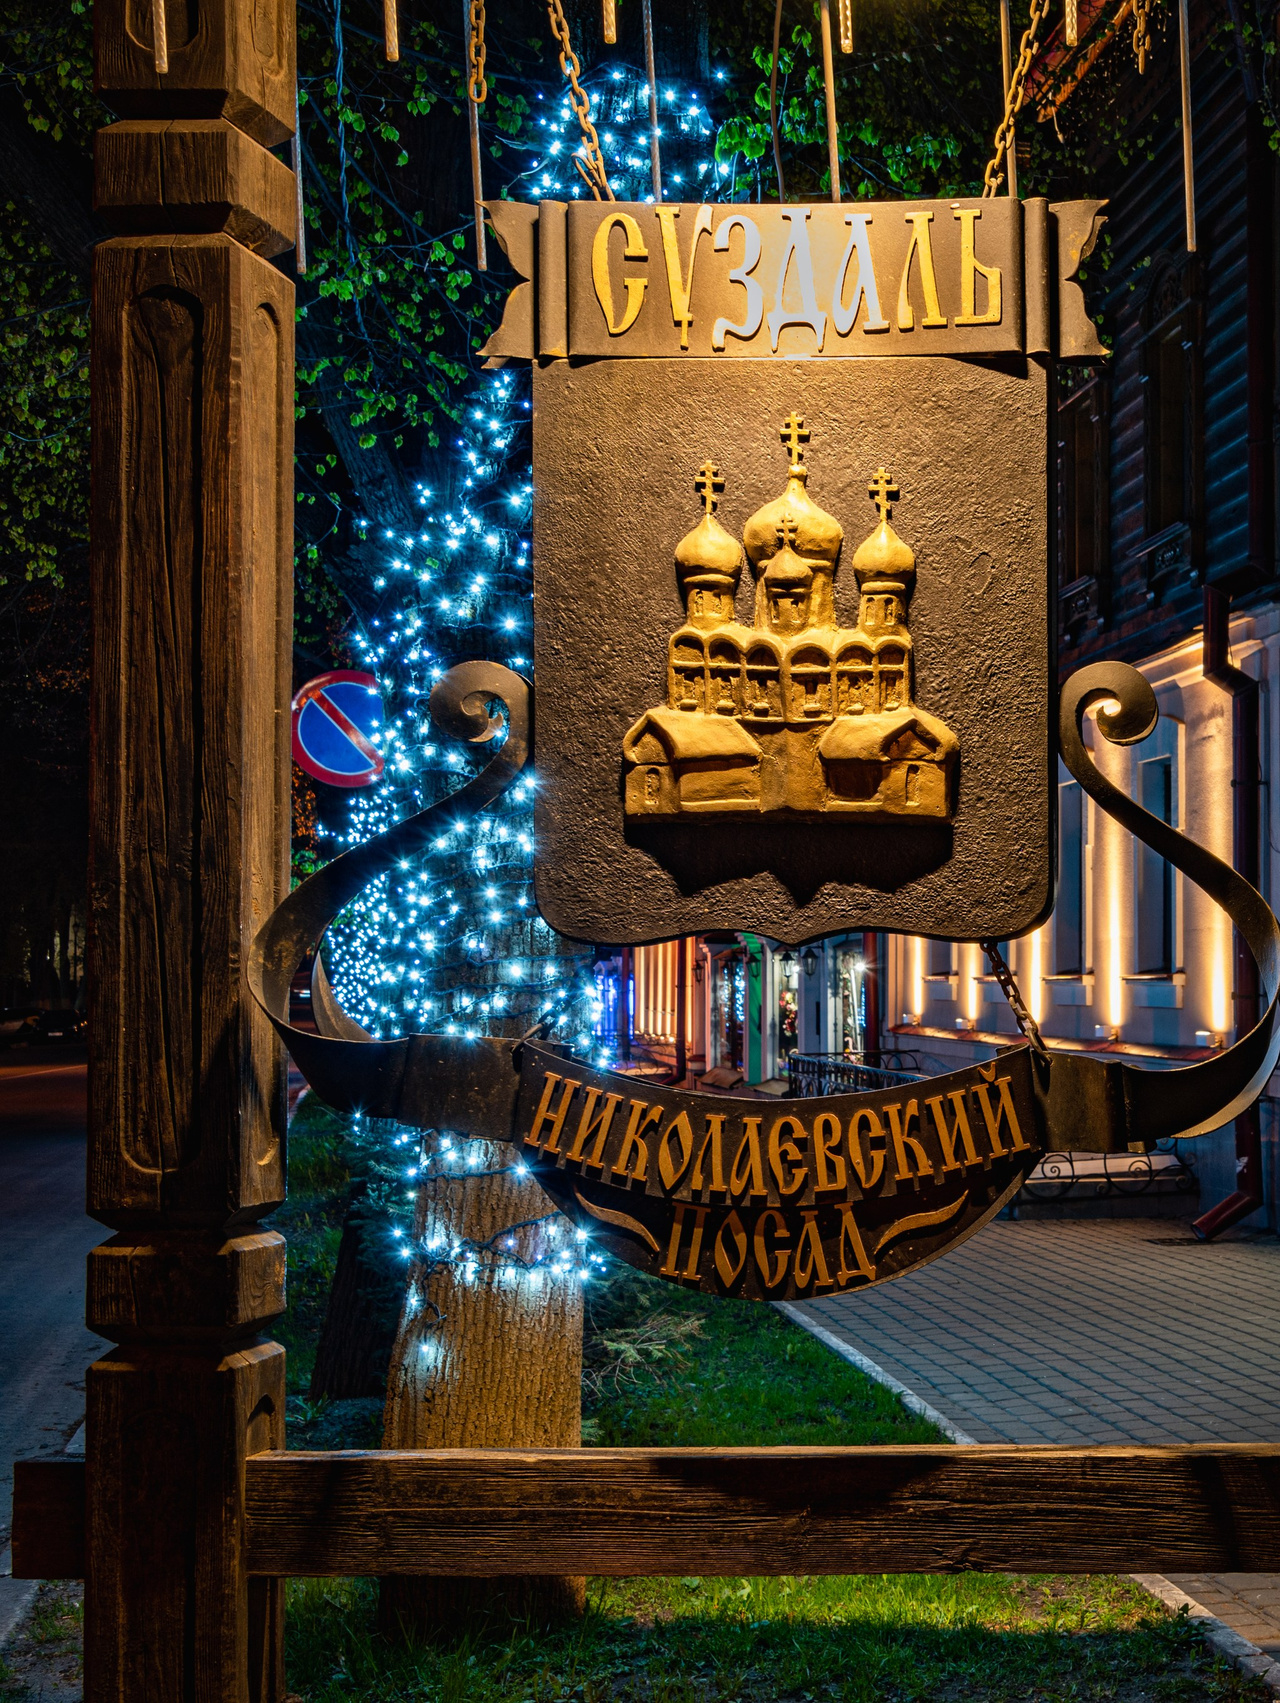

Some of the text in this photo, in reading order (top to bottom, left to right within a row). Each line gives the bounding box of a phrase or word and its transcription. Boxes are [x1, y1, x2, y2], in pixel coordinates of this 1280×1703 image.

[591, 205, 1003, 352] СУЗДАЛЬ
[523, 1062, 1031, 1196] НИКОЛАЕВСКИЙ
[660, 1202, 876, 1288] ПОСАД
